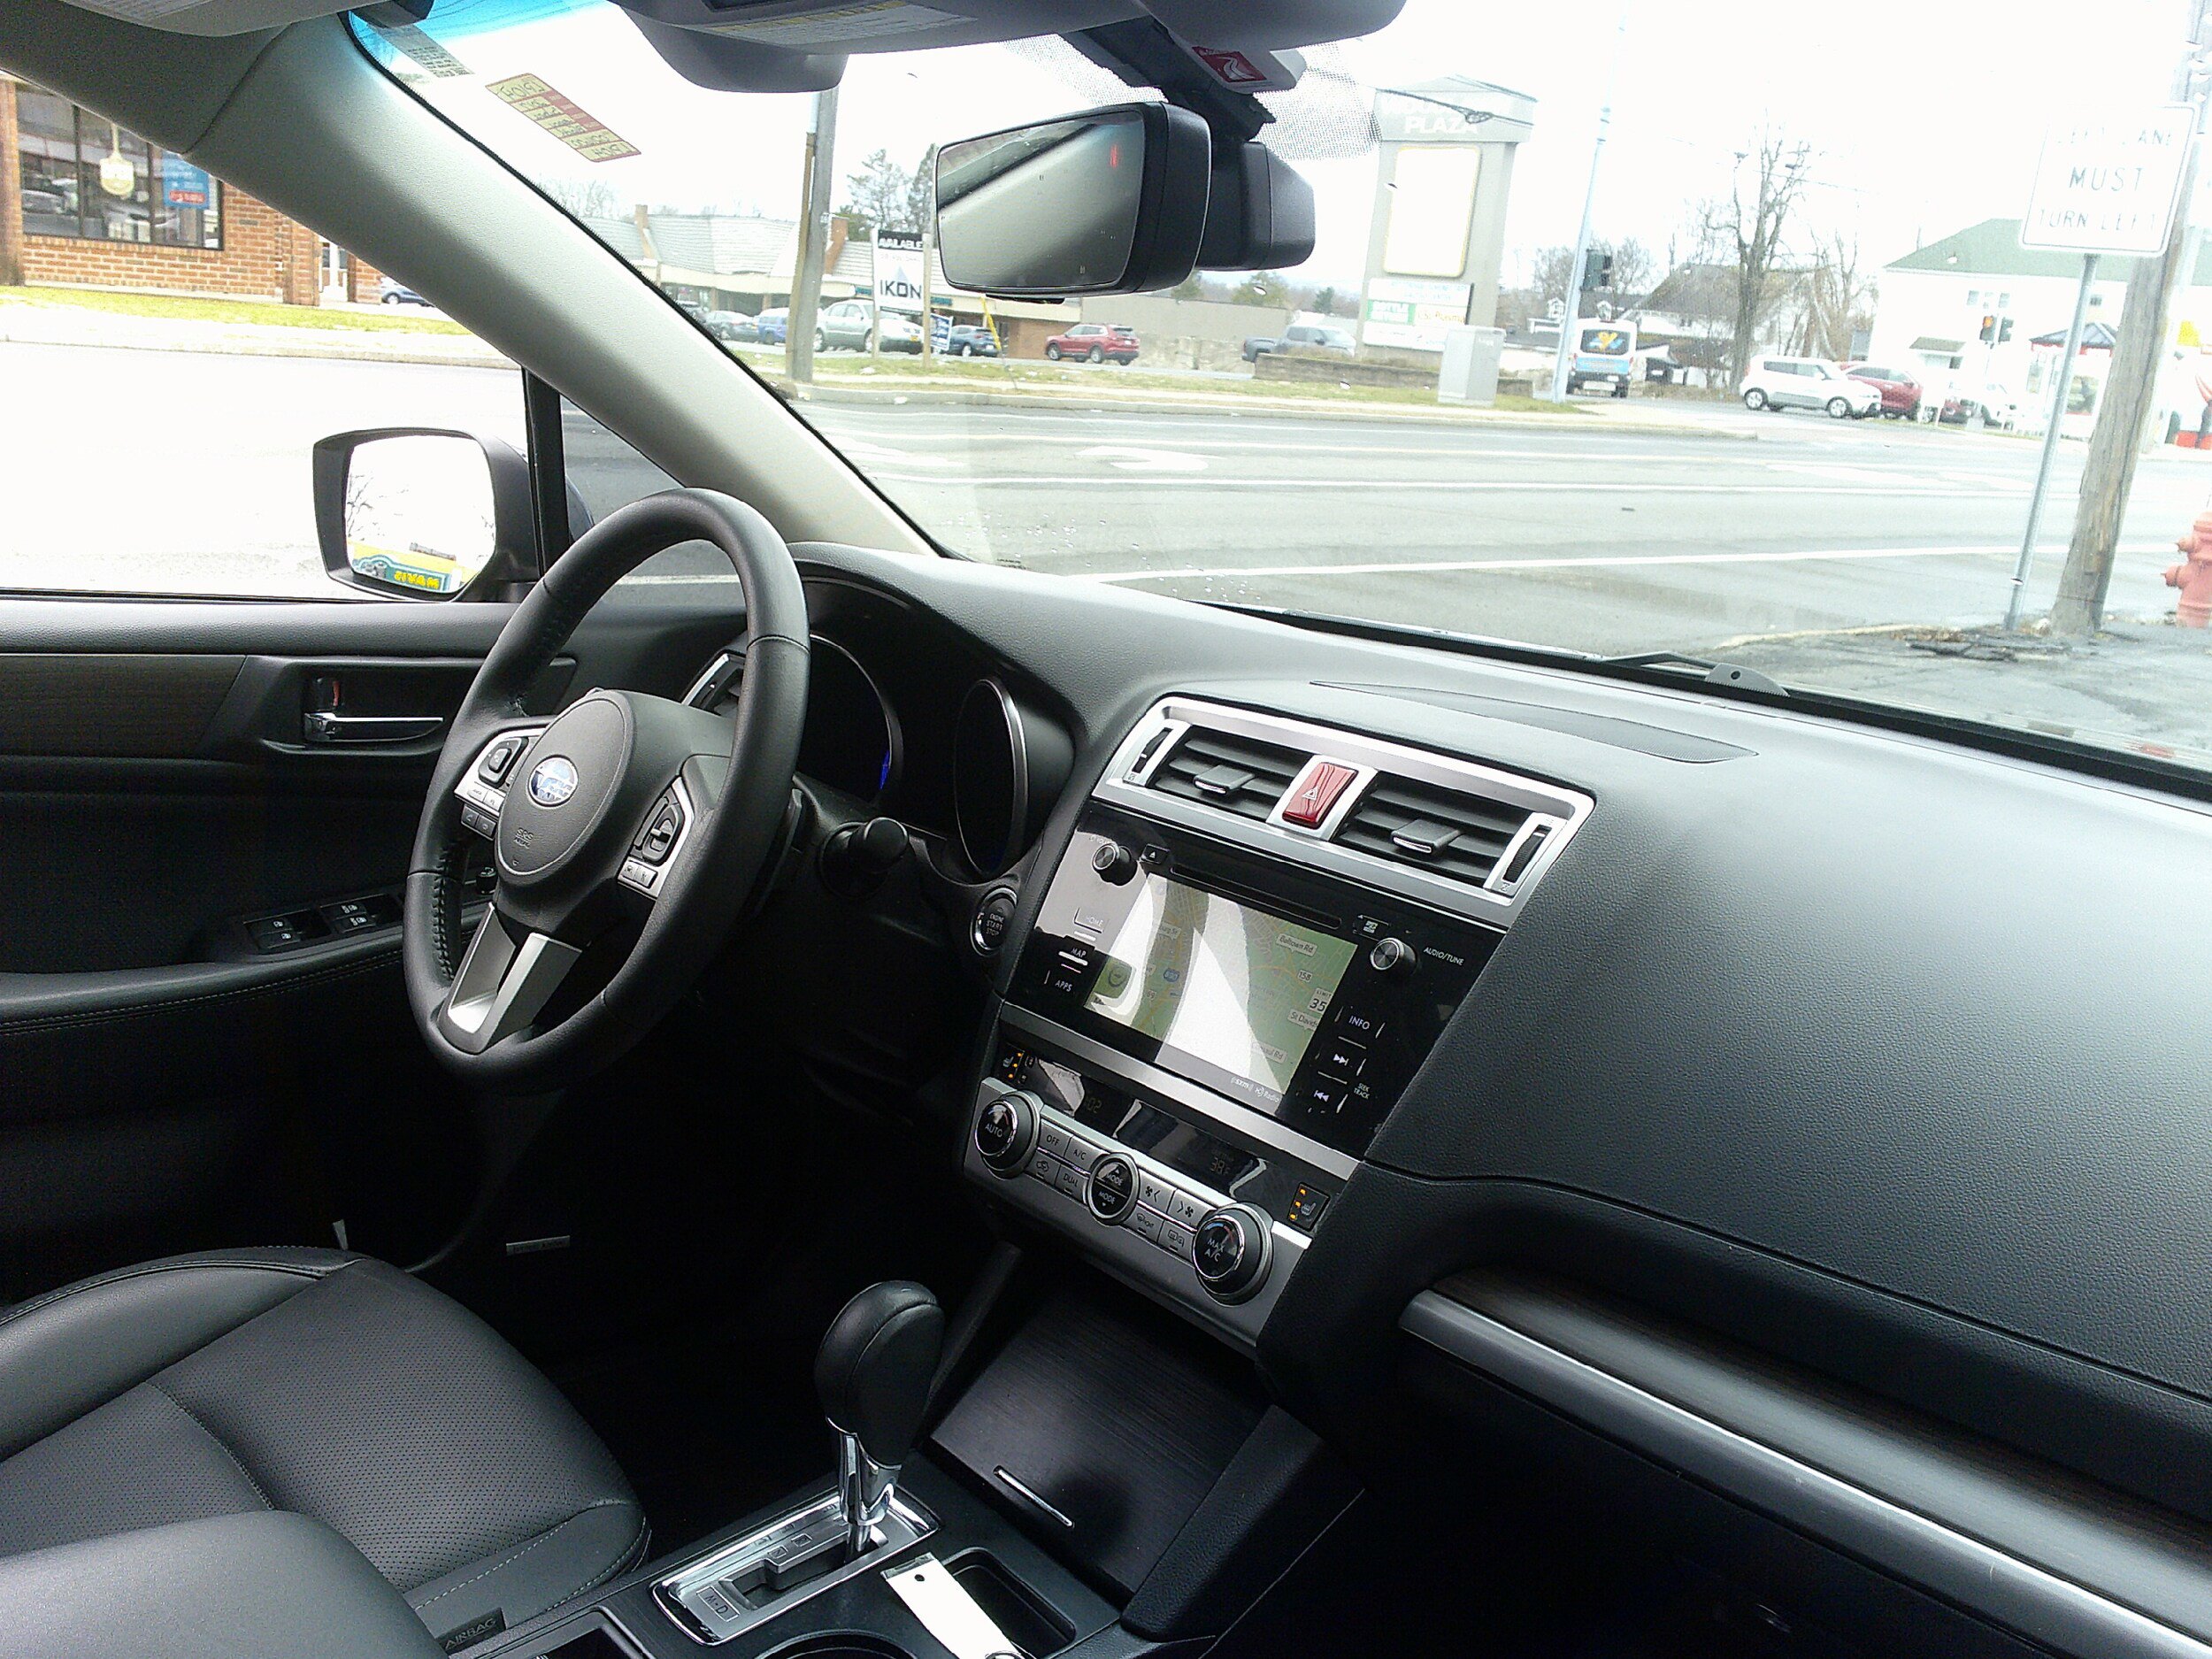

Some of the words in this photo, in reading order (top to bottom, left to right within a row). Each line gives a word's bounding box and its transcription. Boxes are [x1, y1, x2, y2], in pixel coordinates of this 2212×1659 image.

[1404, 116, 1479, 134] PLAZA
[2069, 166, 2144, 192] MUST
[2039, 209, 2089, 228] TURN
[879, 279, 922, 300] IKON
[986, 920, 1003, 931] START
[1071, 948, 1087, 957] MAP
[1303, 943, 1314, 954] Rd
[1423, 946, 1464, 966] AUDIO/TUNE
[1298, 971, 1312, 981] 158
[1055, 979, 1073, 993] APPS
[1316, 989, 1333, 998] LIMIT
[1310, 997, 1326, 1013] 35
[1348, 1015, 1371, 1030] INFO
[1274, 1050, 1284, 1060] Rd
[985, 1124, 1003, 1138] AUTO
[1046, 1134, 1061, 1147] OFF
[1073, 1148, 1087, 1161] A/C
[1064, 1172, 1079, 1187] DUAL
[1098, 1191, 1116, 1205] MODE
[1206, 1238, 1225, 1254] MAX
[1204, 1249, 1221, 1263] A/C
[444, 1617, 496, 1651] AIRBAG
